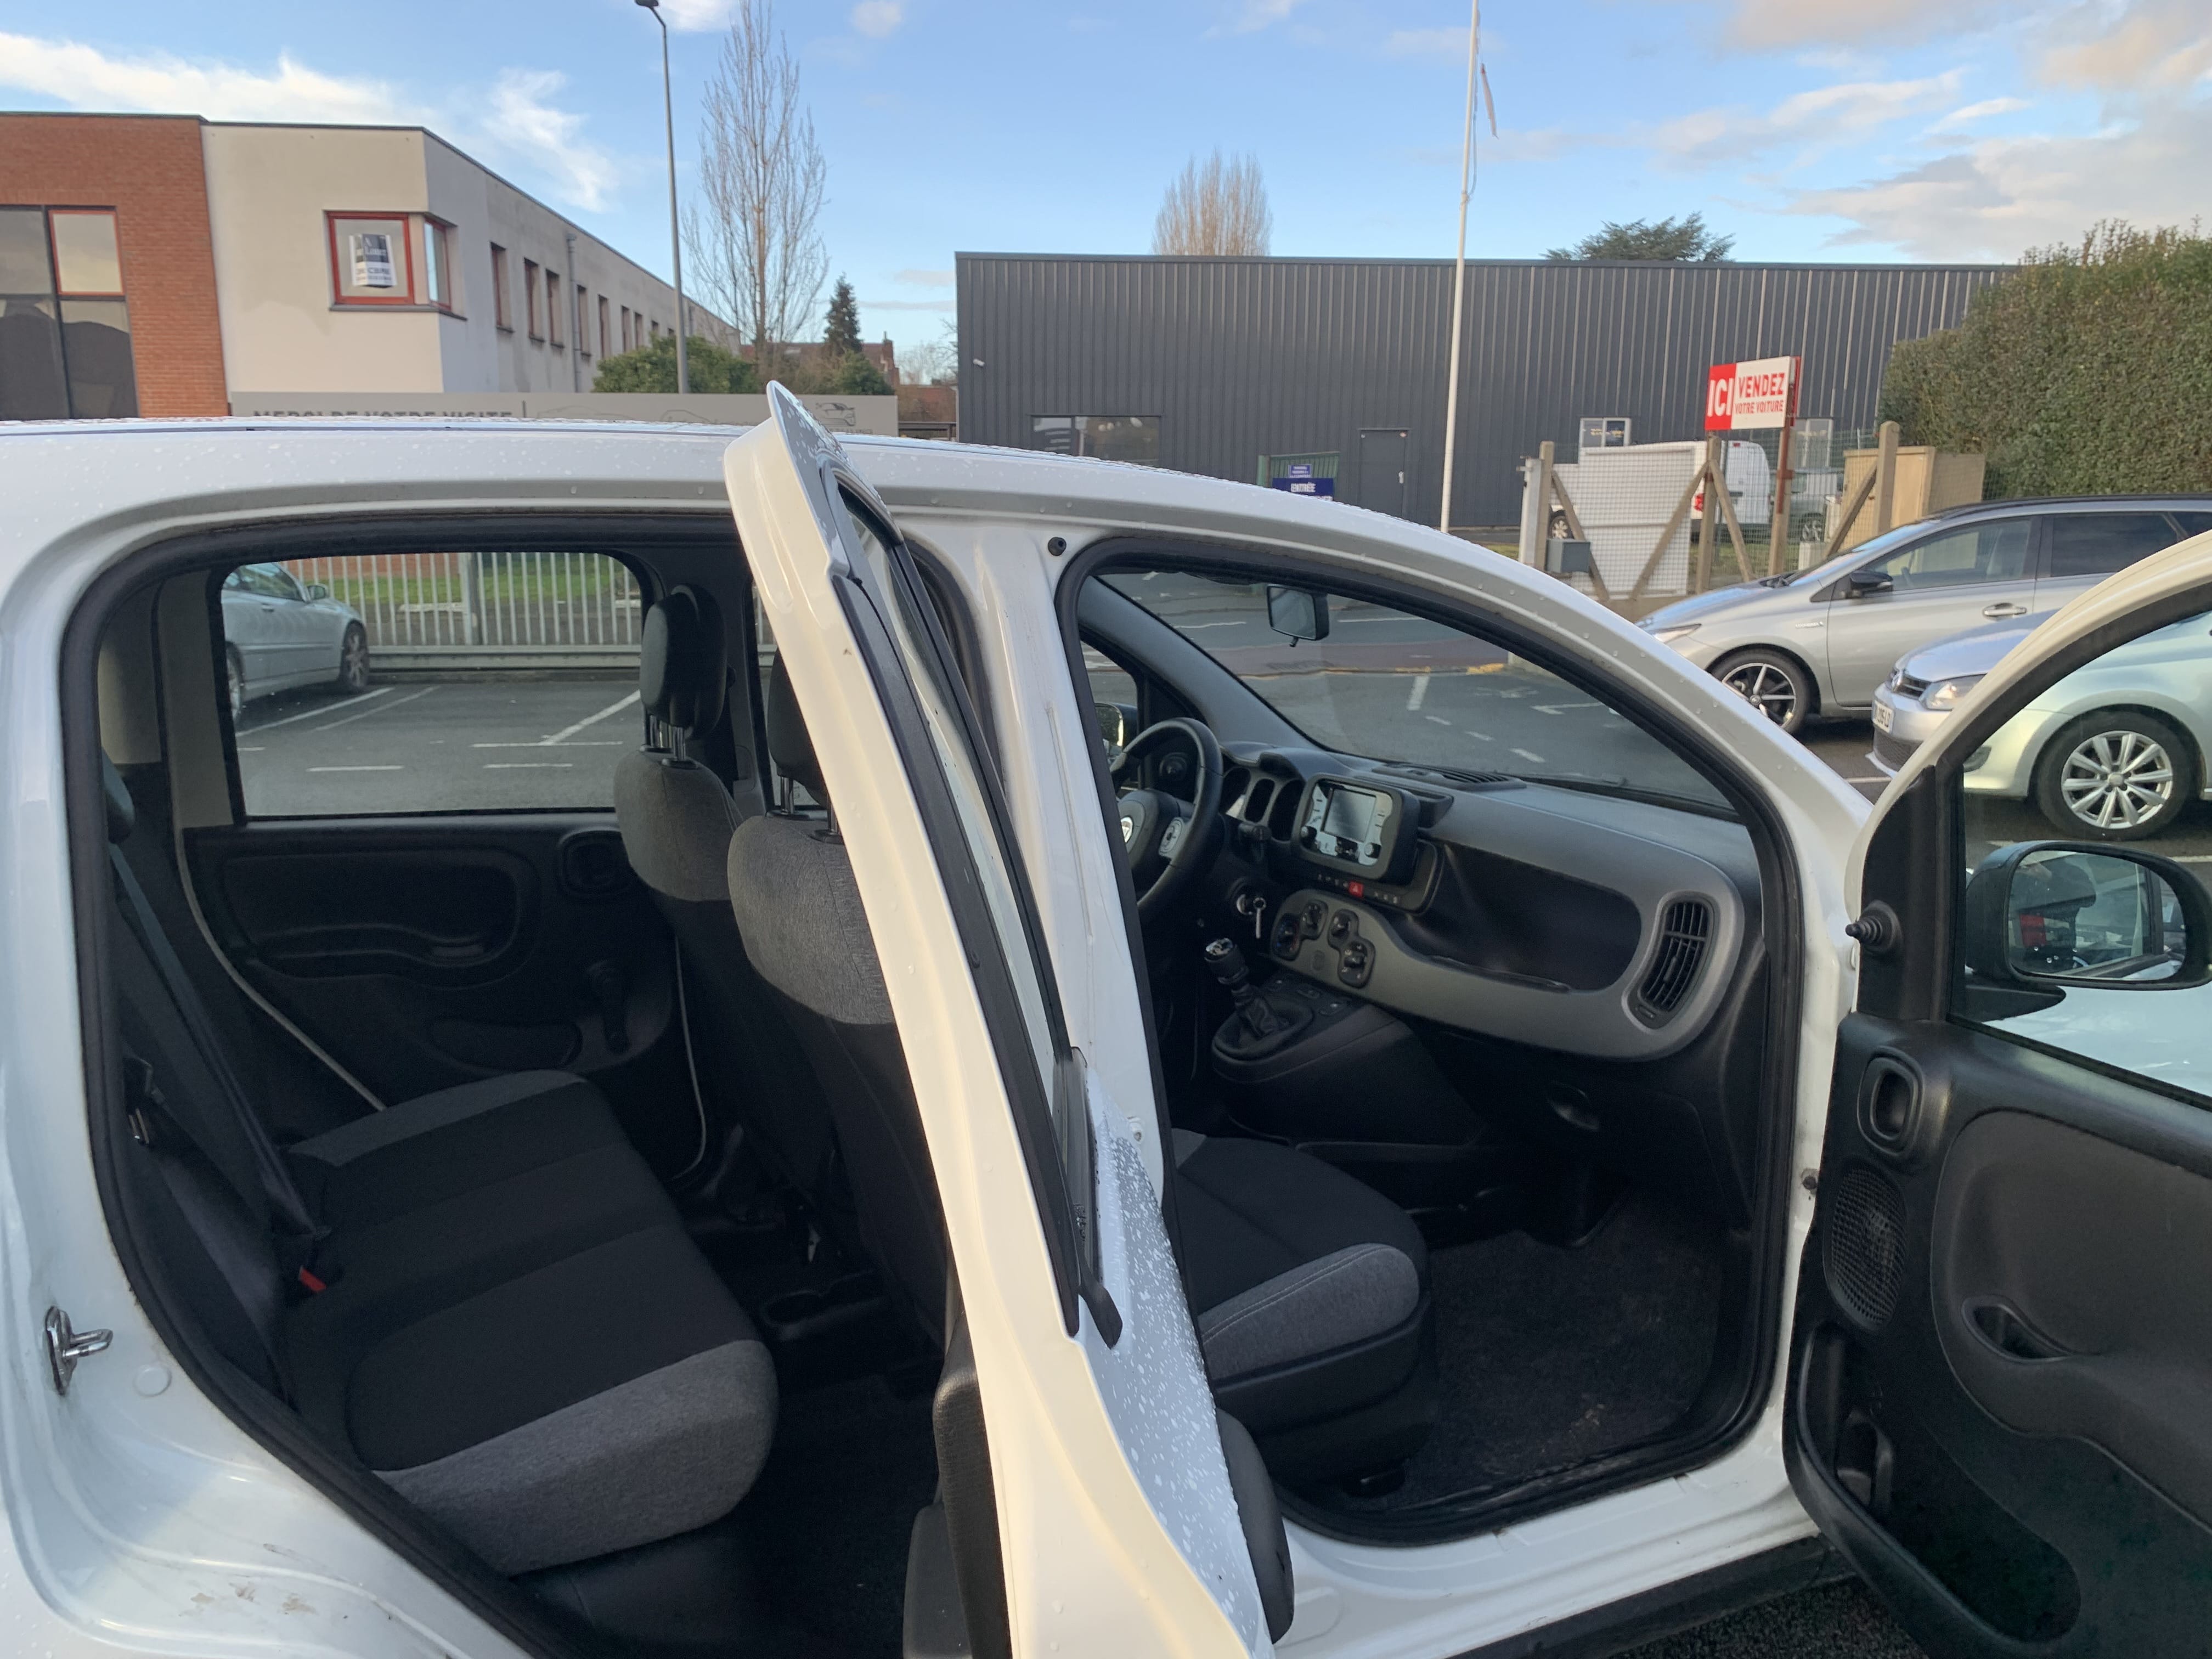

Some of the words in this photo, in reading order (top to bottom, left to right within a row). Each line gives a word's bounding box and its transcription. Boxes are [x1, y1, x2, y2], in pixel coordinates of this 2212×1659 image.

[1739, 373, 1785, 397] VENDEZ
[1707, 378, 1734, 417] ICI
[1735, 402, 1754, 414] VOTRE
[1756, 400, 1784, 412] VOITURE
